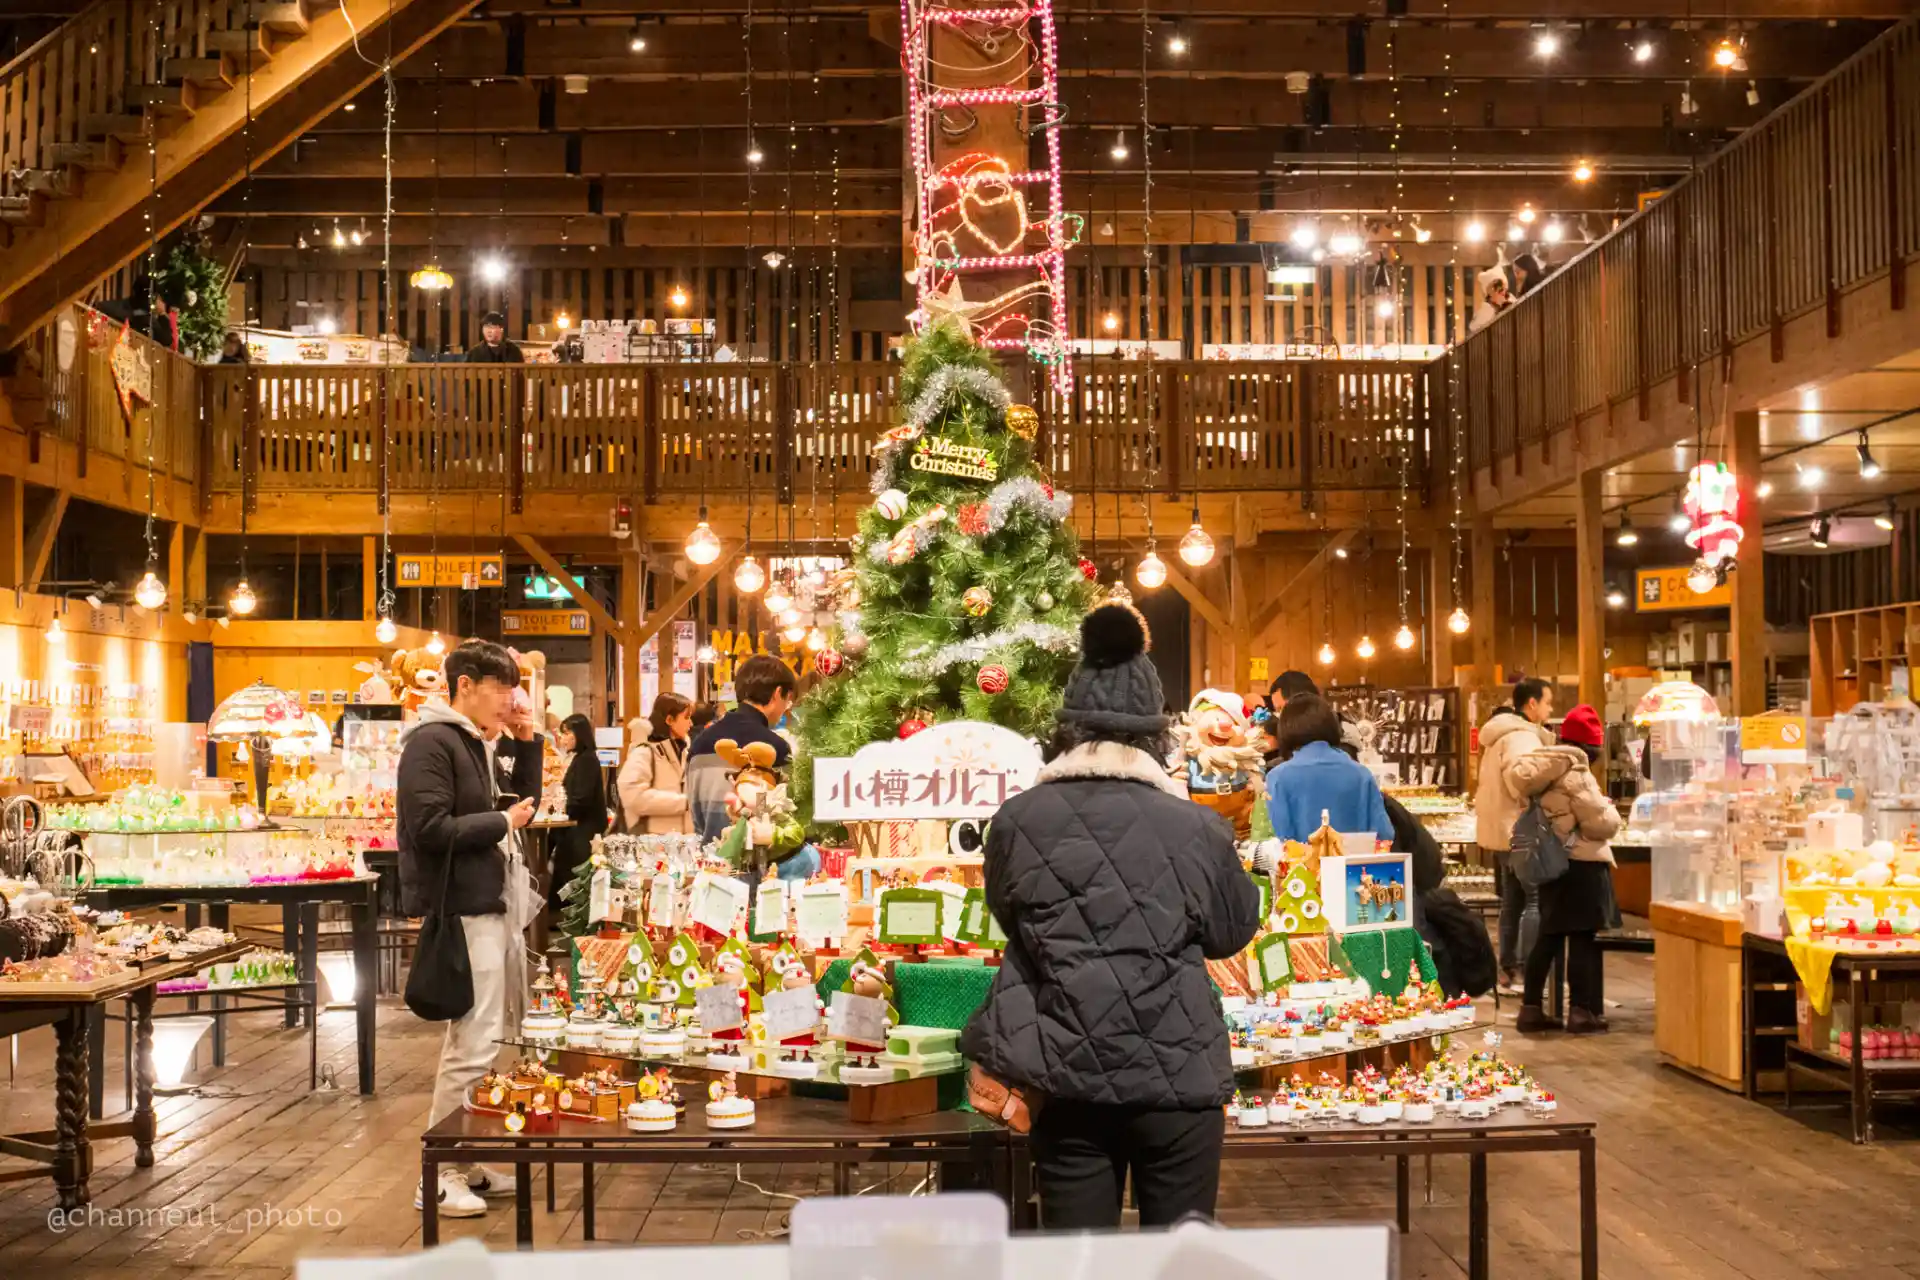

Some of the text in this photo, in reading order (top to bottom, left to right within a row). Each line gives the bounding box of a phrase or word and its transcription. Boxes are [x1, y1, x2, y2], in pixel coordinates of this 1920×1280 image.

[930, 436, 991, 465] Merry
[909, 453, 998, 482] Christmas
[423, 561, 476, 573] TOILET
[524, 614, 568, 625] TOILET
